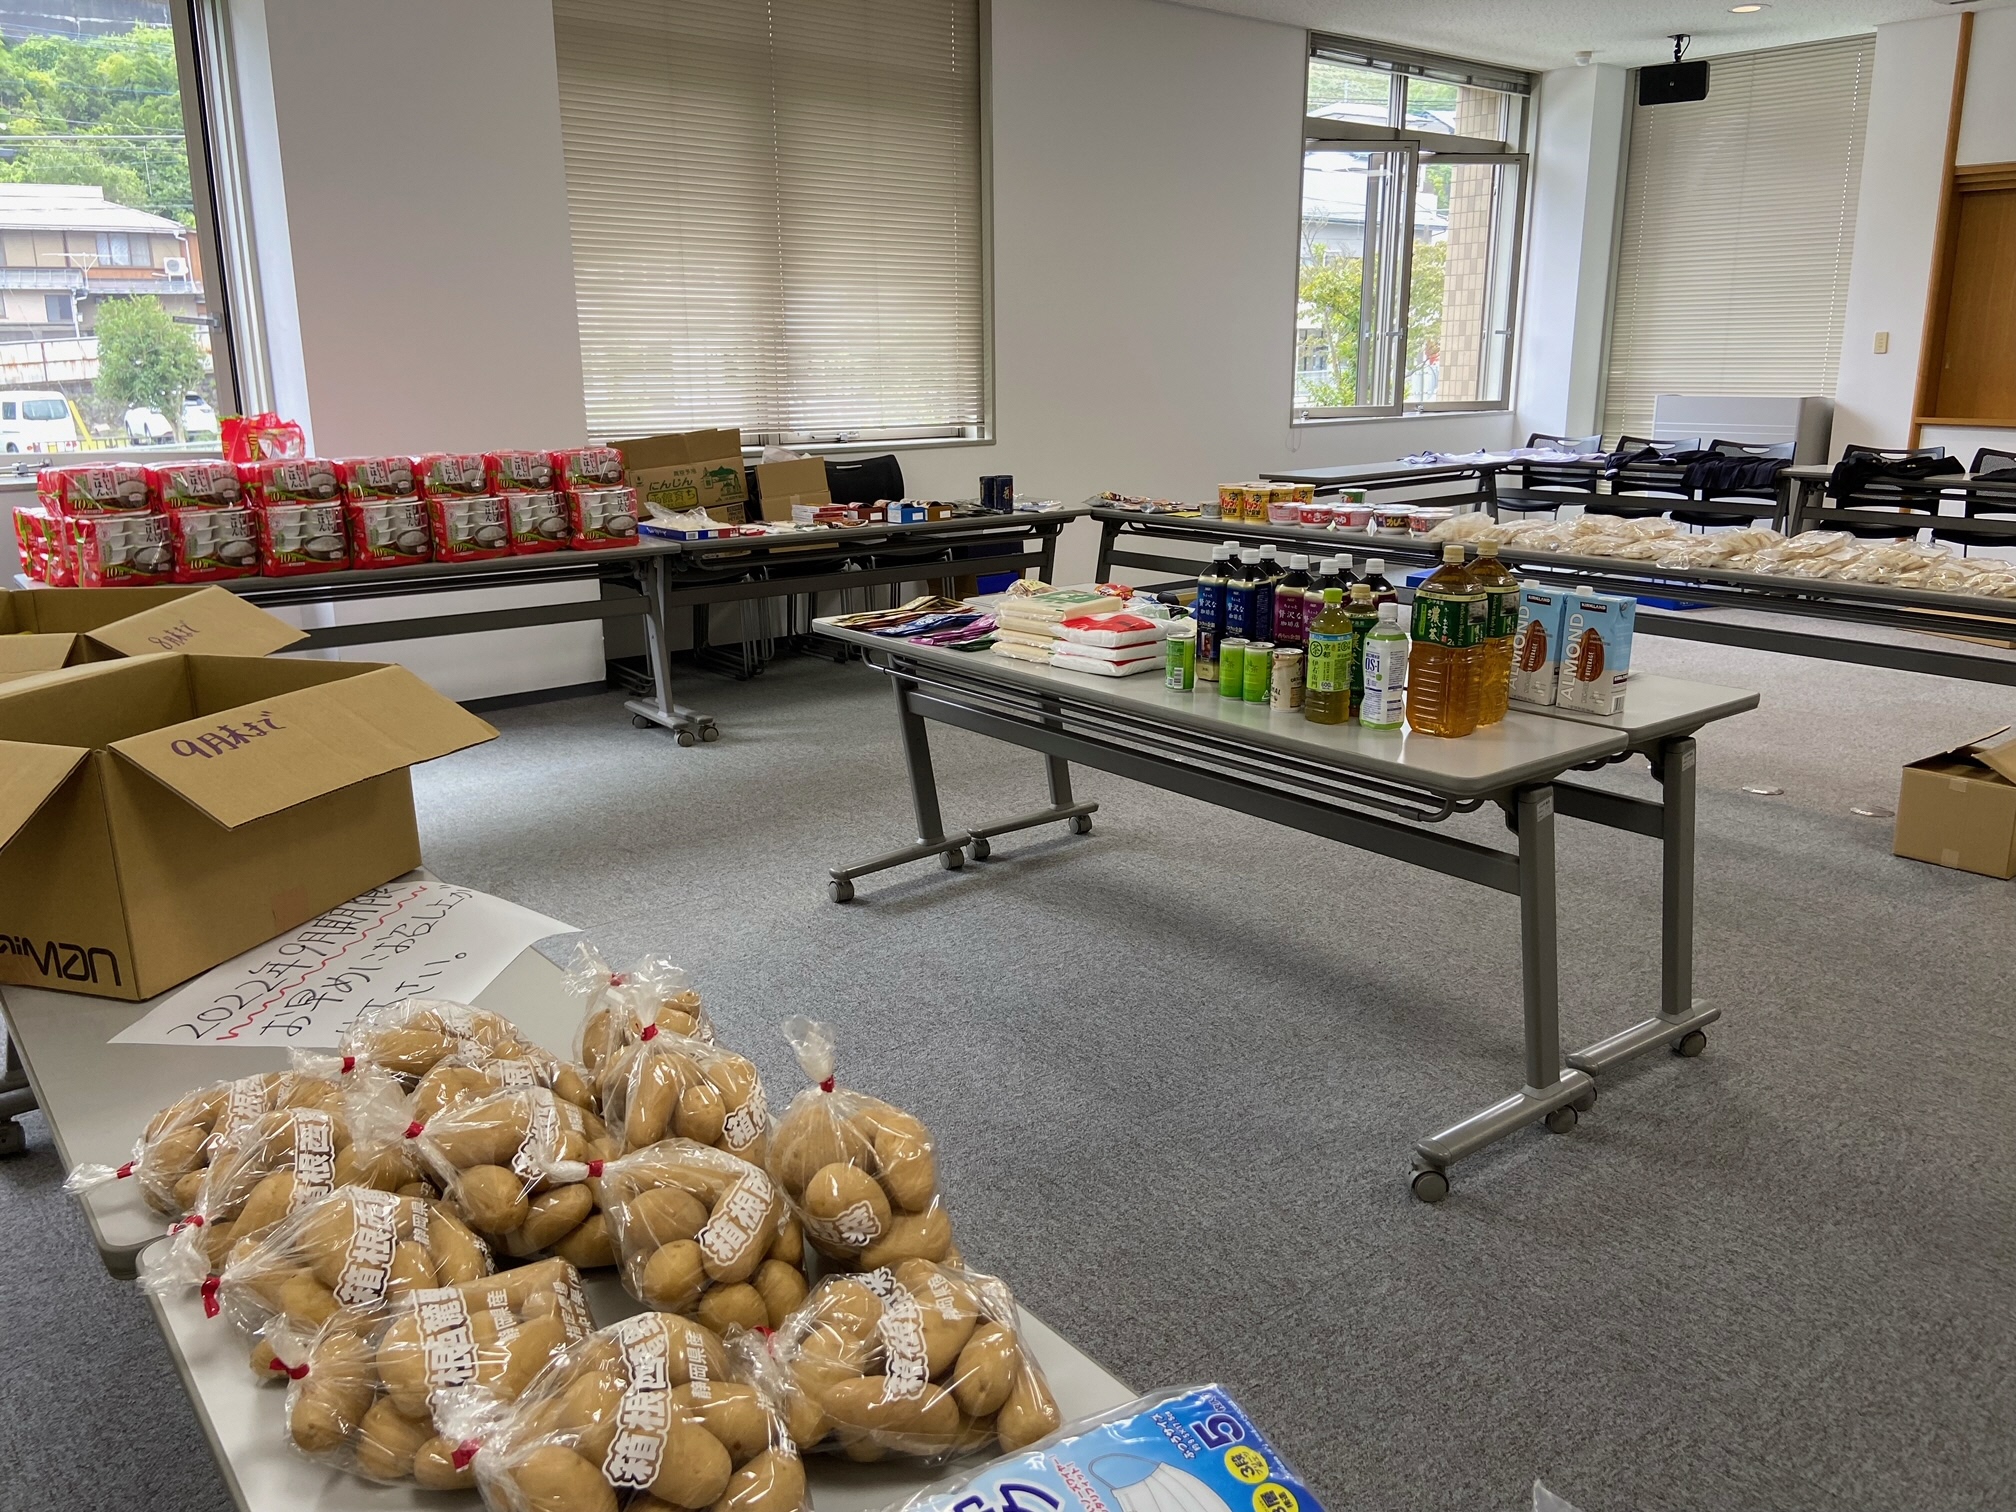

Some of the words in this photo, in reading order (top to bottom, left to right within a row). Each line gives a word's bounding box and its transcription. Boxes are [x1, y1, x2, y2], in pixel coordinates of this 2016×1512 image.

[369, 462, 380, 484] ごはん
[514, 457, 524, 477] ごはん
[583, 454, 591, 473] ごはん
[93, 472, 106, 497] ごはん
[189, 469, 200, 493] ごはん
[197, 470, 208, 492] おいしい
[288, 465, 298, 488] ごはん
[649, 477, 693, 491] にんじん
[317, 510, 326, 532] ごはん
[148, 619, 200, 650] 8月末まで
[1509, 606, 1530, 690] ALMOND
[1529, 644, 1538, 666] BEVERAGE
[1561, 613, 1584, 700] ALMOND
[1365, 658, 1380, 672] OS-1
[1585, 652, 1594, 676] BEVERAGE
[170, 710, 287, 758] 9月末まで
[684, 1330, 712, 1400] 静岡県産
[1152, 1412, 1196, 1460] ふつうサイズ
[1190, 1413, 1246, 1450] 5
[1230, 1452, 1256, 1478] 3段
